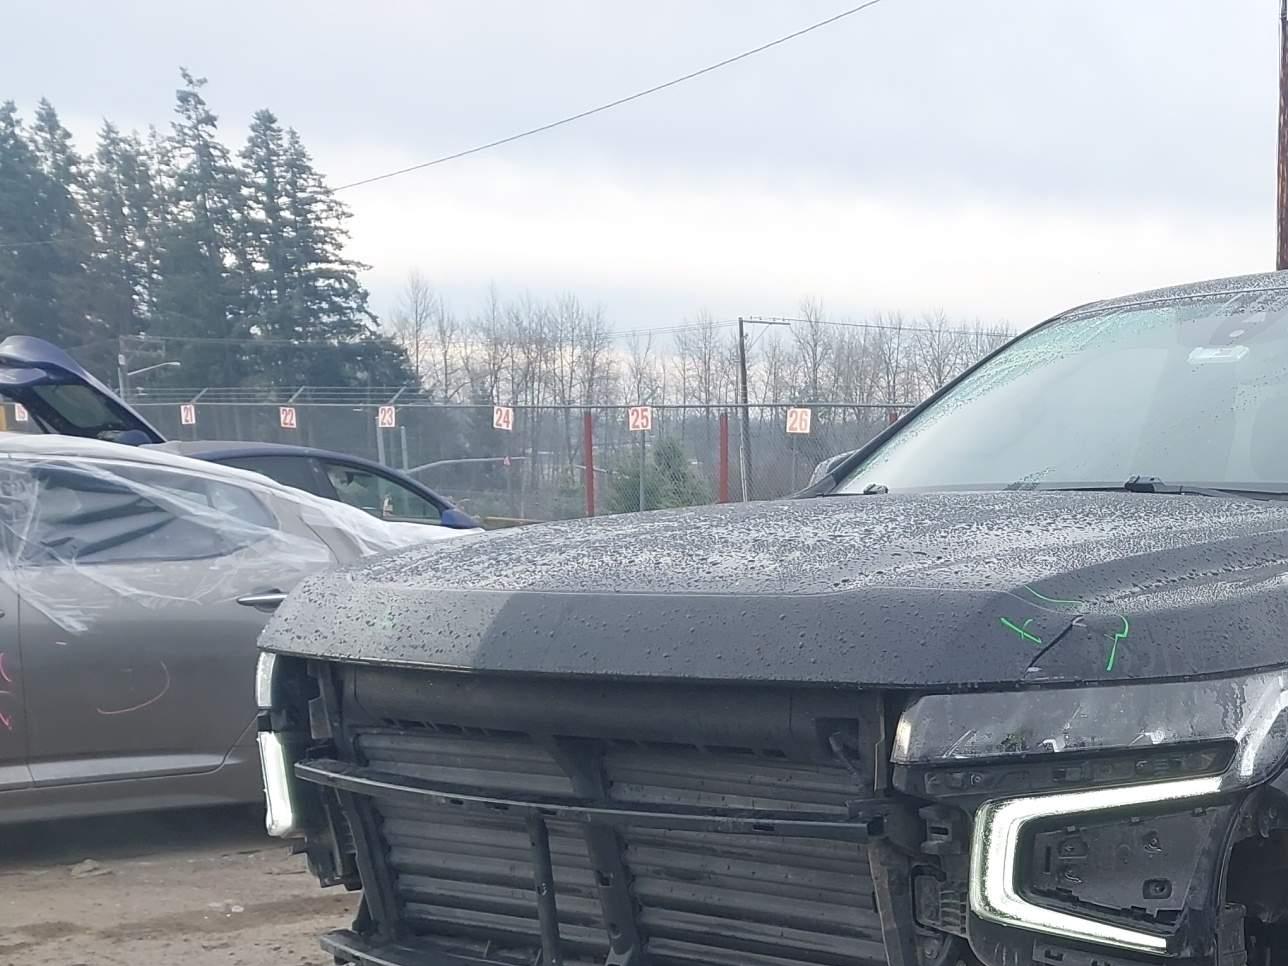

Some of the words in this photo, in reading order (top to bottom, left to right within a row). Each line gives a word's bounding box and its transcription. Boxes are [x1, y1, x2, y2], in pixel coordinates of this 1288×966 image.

[281, 408, 295, 426] 22
[380, 407, 394, 426] 23
[495, 408, 511, 428] 24
[631, 408, 649, 429] 25
[788, 410, 808, 431] 26
